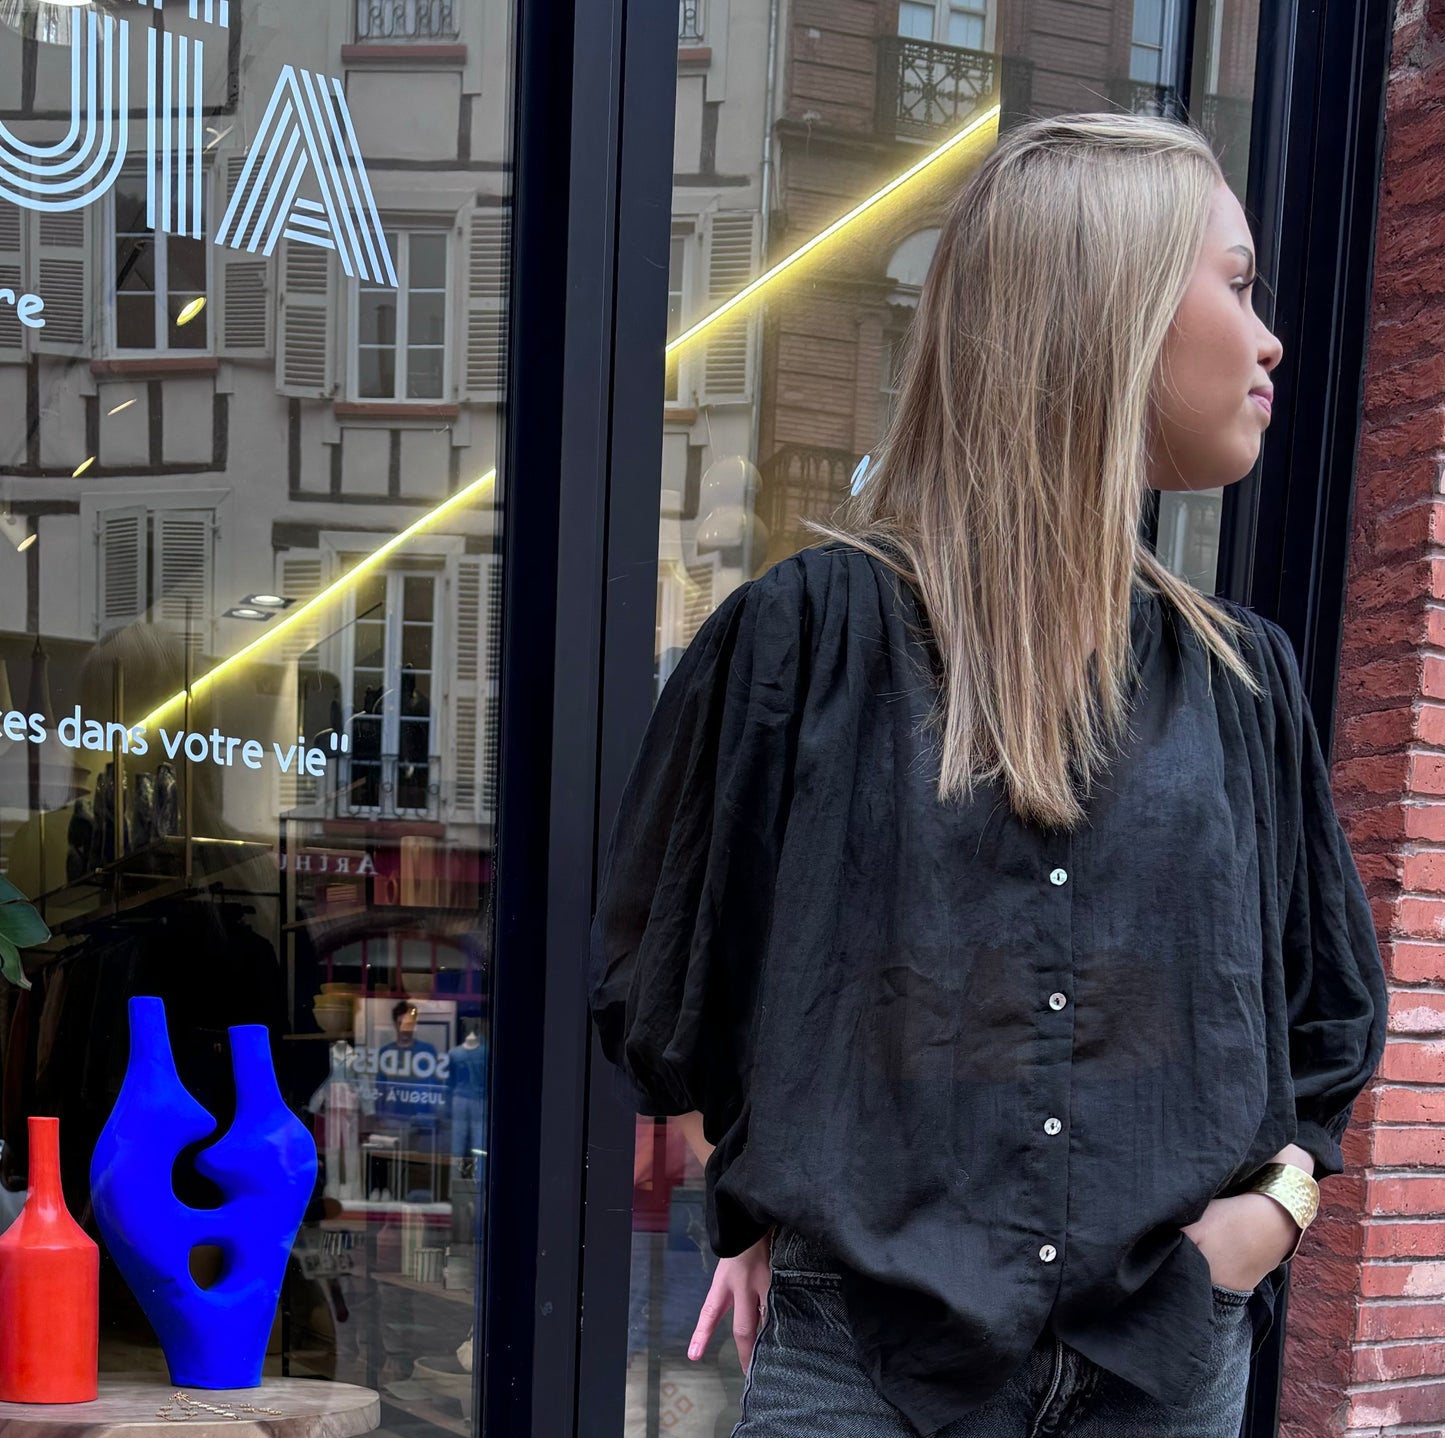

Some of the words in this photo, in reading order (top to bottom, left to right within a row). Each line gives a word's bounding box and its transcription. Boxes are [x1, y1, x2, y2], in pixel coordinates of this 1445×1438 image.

[0, 710, 47, 744] es
[57, 704, 149, 756] dans
[158, 727, 264, 769] votre
